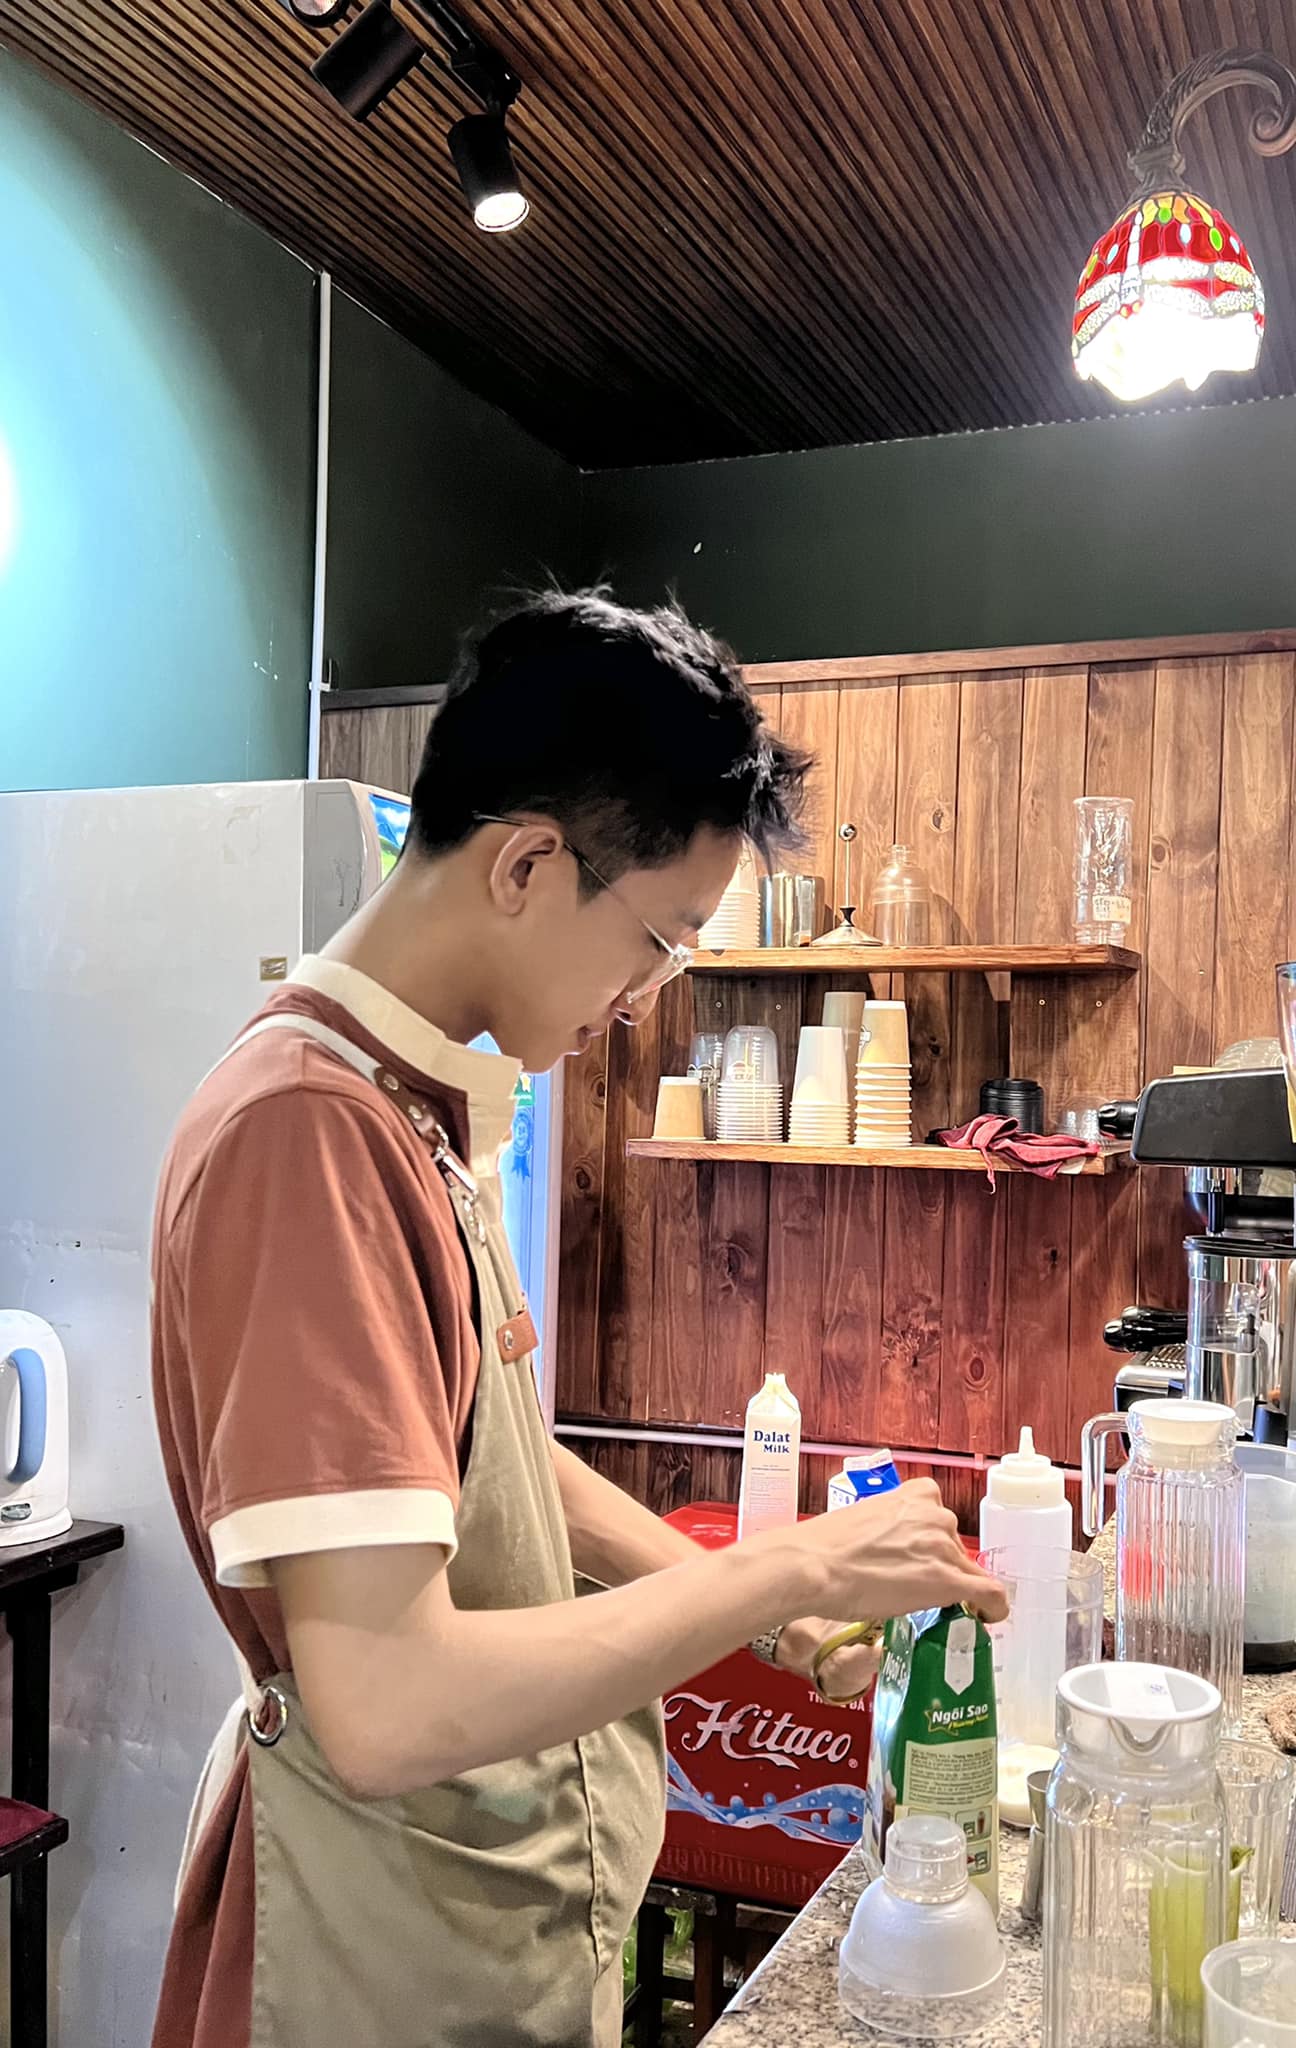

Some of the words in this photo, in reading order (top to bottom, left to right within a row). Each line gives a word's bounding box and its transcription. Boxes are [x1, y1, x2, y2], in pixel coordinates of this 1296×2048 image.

[753, 1430, 791, 1443] Dalat
[763, 1444, 790, 1454] Milk
[966, 1703, 989, 1718] Sao
[662, 1692, 852, 1770] Hitaco
